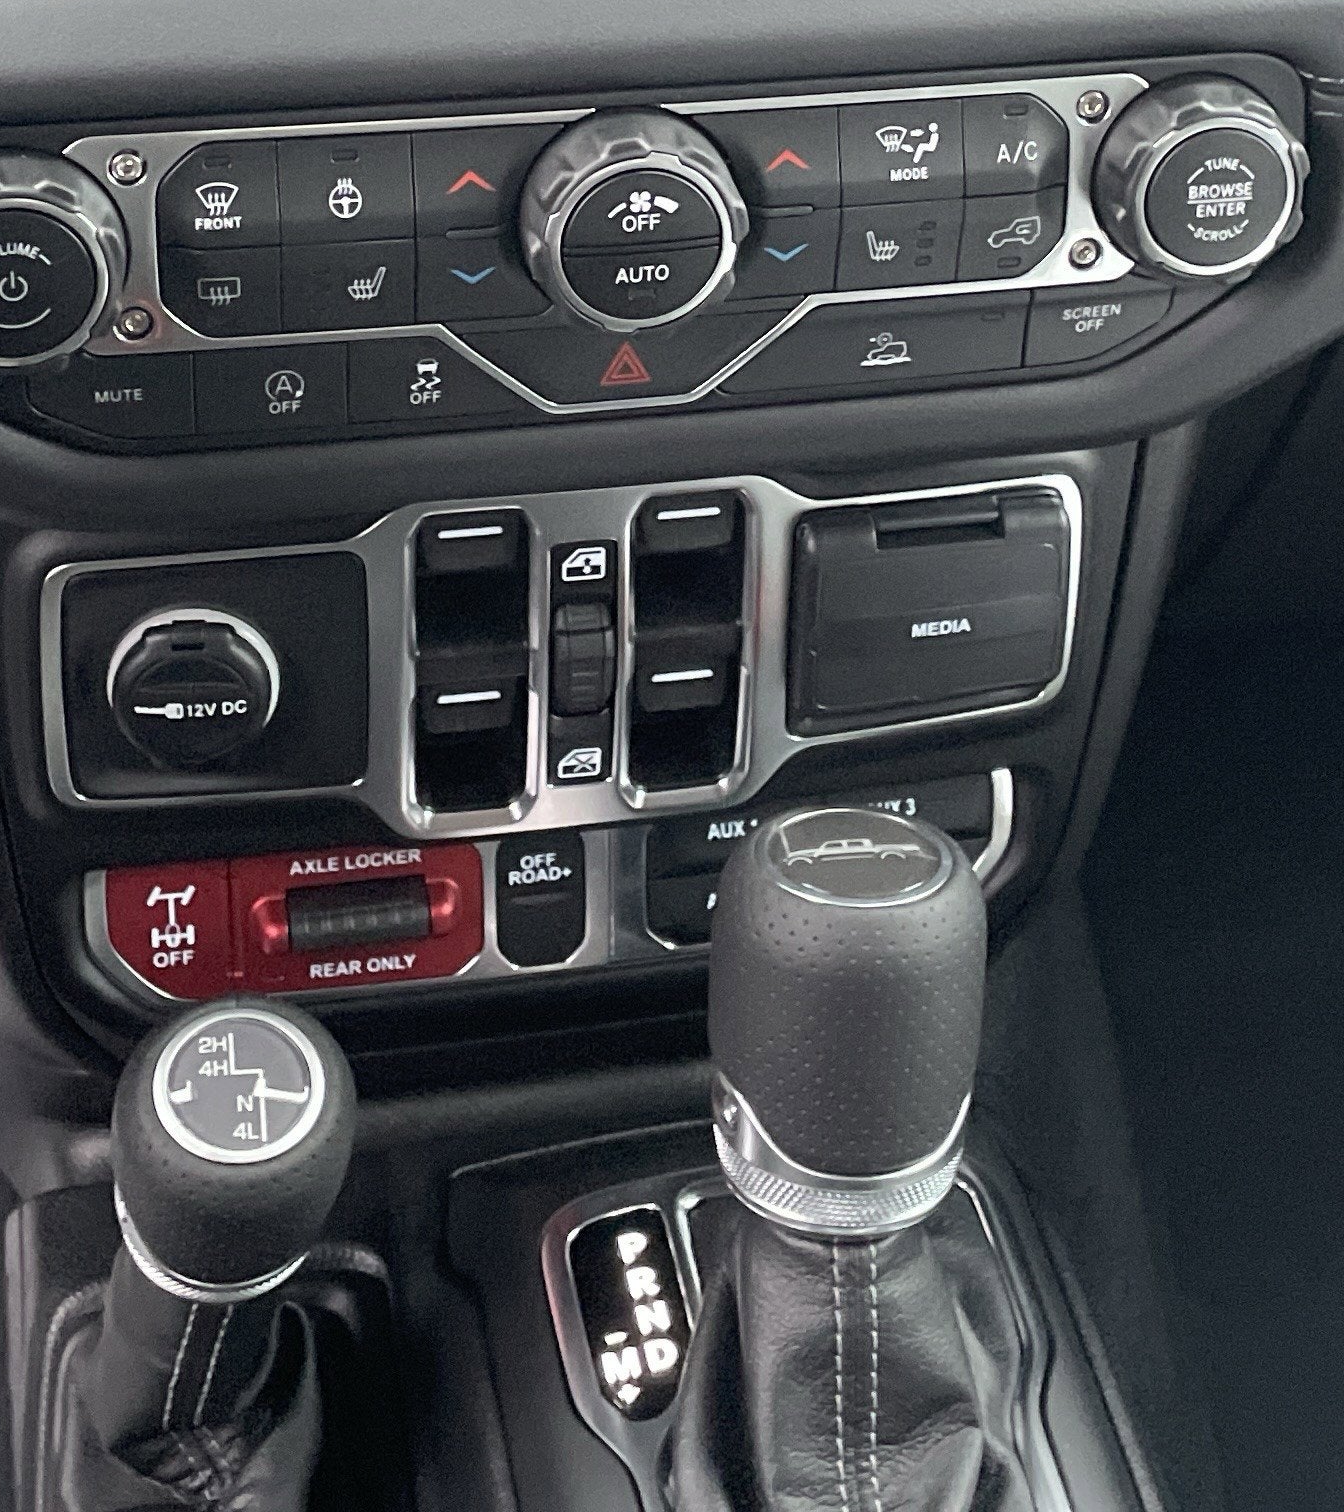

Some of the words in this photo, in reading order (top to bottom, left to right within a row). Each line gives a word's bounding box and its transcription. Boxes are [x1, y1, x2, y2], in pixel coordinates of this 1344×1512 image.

[996, 139, 1039, 168] A/C
[1205, 156, 1240, 173] TUNE
[889, 166, 930, 183] MODE
[1188, 180, 1253, 201] BROWSE
[1196, 201, 1247, 219] ENTER
[194, 215, 243, 232] FRONT
[621, 212, 662, 233] OFF
[1193, 223, 1244, 243] SCROLL
[614, 263, 671, 285] AUTO
[1062, 302, 1123, 323] SCREEN
[1075, 318, 1105, 334] OFF
[94, 388, 144, 405] MUTE
[409, 391, 442, 406] OFF
[268, 399, 302, 415] OFF
[911, 619, 972, 639] MEDIA
[187, 702, 217, 717] 12V
[221, 699, 247, 716] DC
[707, 820, 746, 840] AUX
[289, 856, 339, 876] AXLE
[344, 848, 423, 869] LOCKER
[520, 854, 558, 870] OFF
[153, 950, 194, 968] OFF
[310, 962, 363, 979] REAR
[367, 954, 416, 973] ONLY
[198, 1035, 227, 1054] 2H
[198, 1059, 229, 1077] 4H
[237, 1095, 254, 1111] N
[233, 1121, 260, 1140] 4L
[617, 1232, 647, 1265] P
[625, 1266, 661, 1301] R
[634, 1299, 672, 1336] N
[600, 1346, 642, 1385] M
[643, 1338, 679, 1374] D
